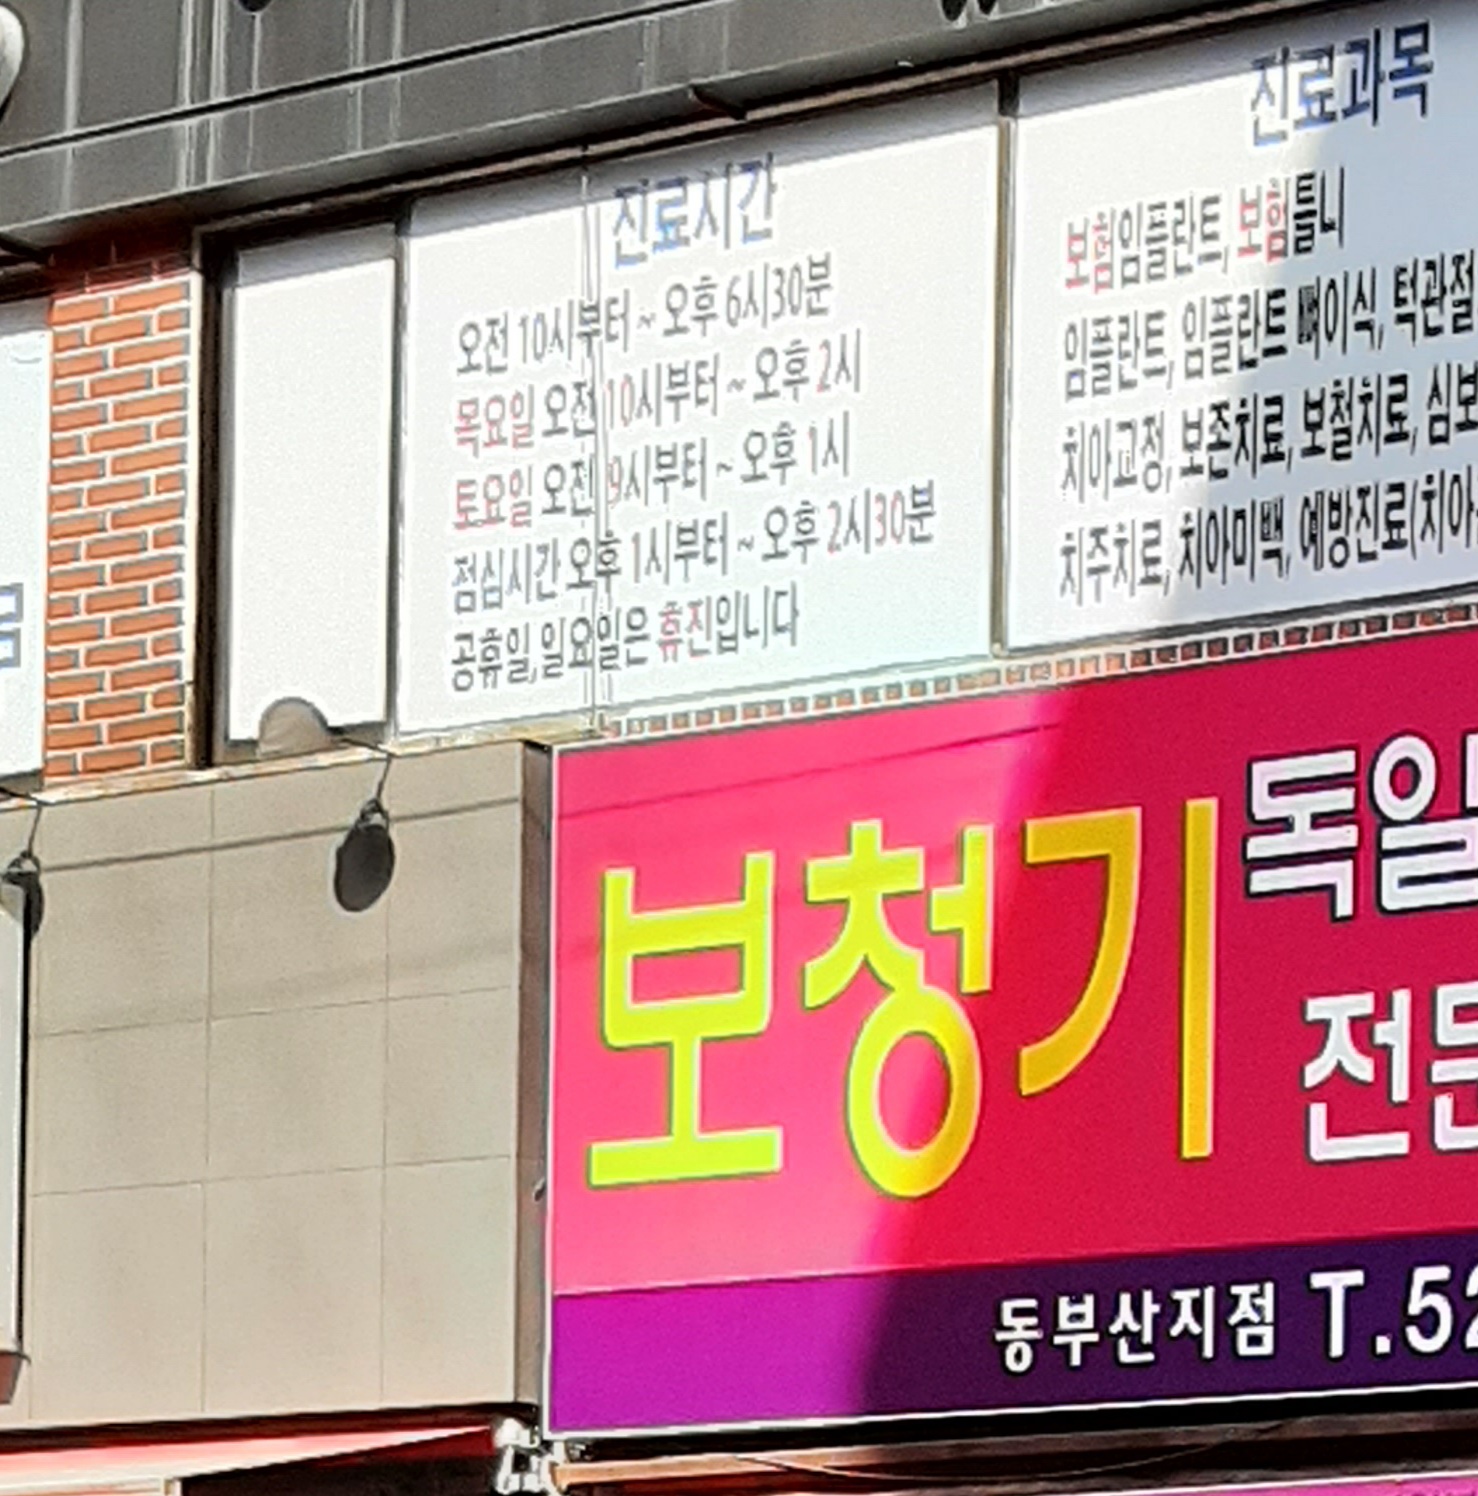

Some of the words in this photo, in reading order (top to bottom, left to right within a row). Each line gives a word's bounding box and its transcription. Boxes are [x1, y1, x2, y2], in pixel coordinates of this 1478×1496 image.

[1250, 20, 1434, 147] 진료과목
[613, 152, 778, 268] 진료시간
[1065, 193, 1230, 293] 보험임플란트,
[1237, 166, 1345, 262] 보험틀니
[456, 308, 508, 376] 오전
[517, 287, 629, 362] 10시부터
[663, 274, 718, 338] 오후
[724, 251, 832, 330] 6시30분
[1064, 308, 1175, 402] 임플란트,
[1181, 288, 1288, 377] 임플란트
[454, 390, 534, 458] 목요일
[541, 383, 595, 437] 오전
[603, 352, 719, 430] 10시부터
[753, 339, 810, 402] 오후
[817, 328, 862, 394] 2시
[1061, 402, 1173, 503] 치아교정,
[1179, 393, 1293, 480] 보존치료,
[1300, 373, 1419, 465] 보철치료,
[453, 465, 534, 531] 토요일
[541, 454, 594, 517] 오전
[605, 436, 707, 507] 9시부터
[740, 419, 796, 484] 오후
[806, 410, 850, 477] 1시
[453, 534, 562, 616] 점심시간
[565, 527, 622, 592] 오후
[630, 510, 729, 585] 1시부터
[760, 500, 820, 566] 오후
[826, 479, 938, 554] 2시30분
[1060, 519, 1172, 606] 치주치료,
[1178, 492, 1292, 590] 치아미백,
[656, 581, 800, 662] 휴진입니다
[588, 797, 1219, 1200] 보청기
[994, 1280, 1277, 1374] 동부산지점
